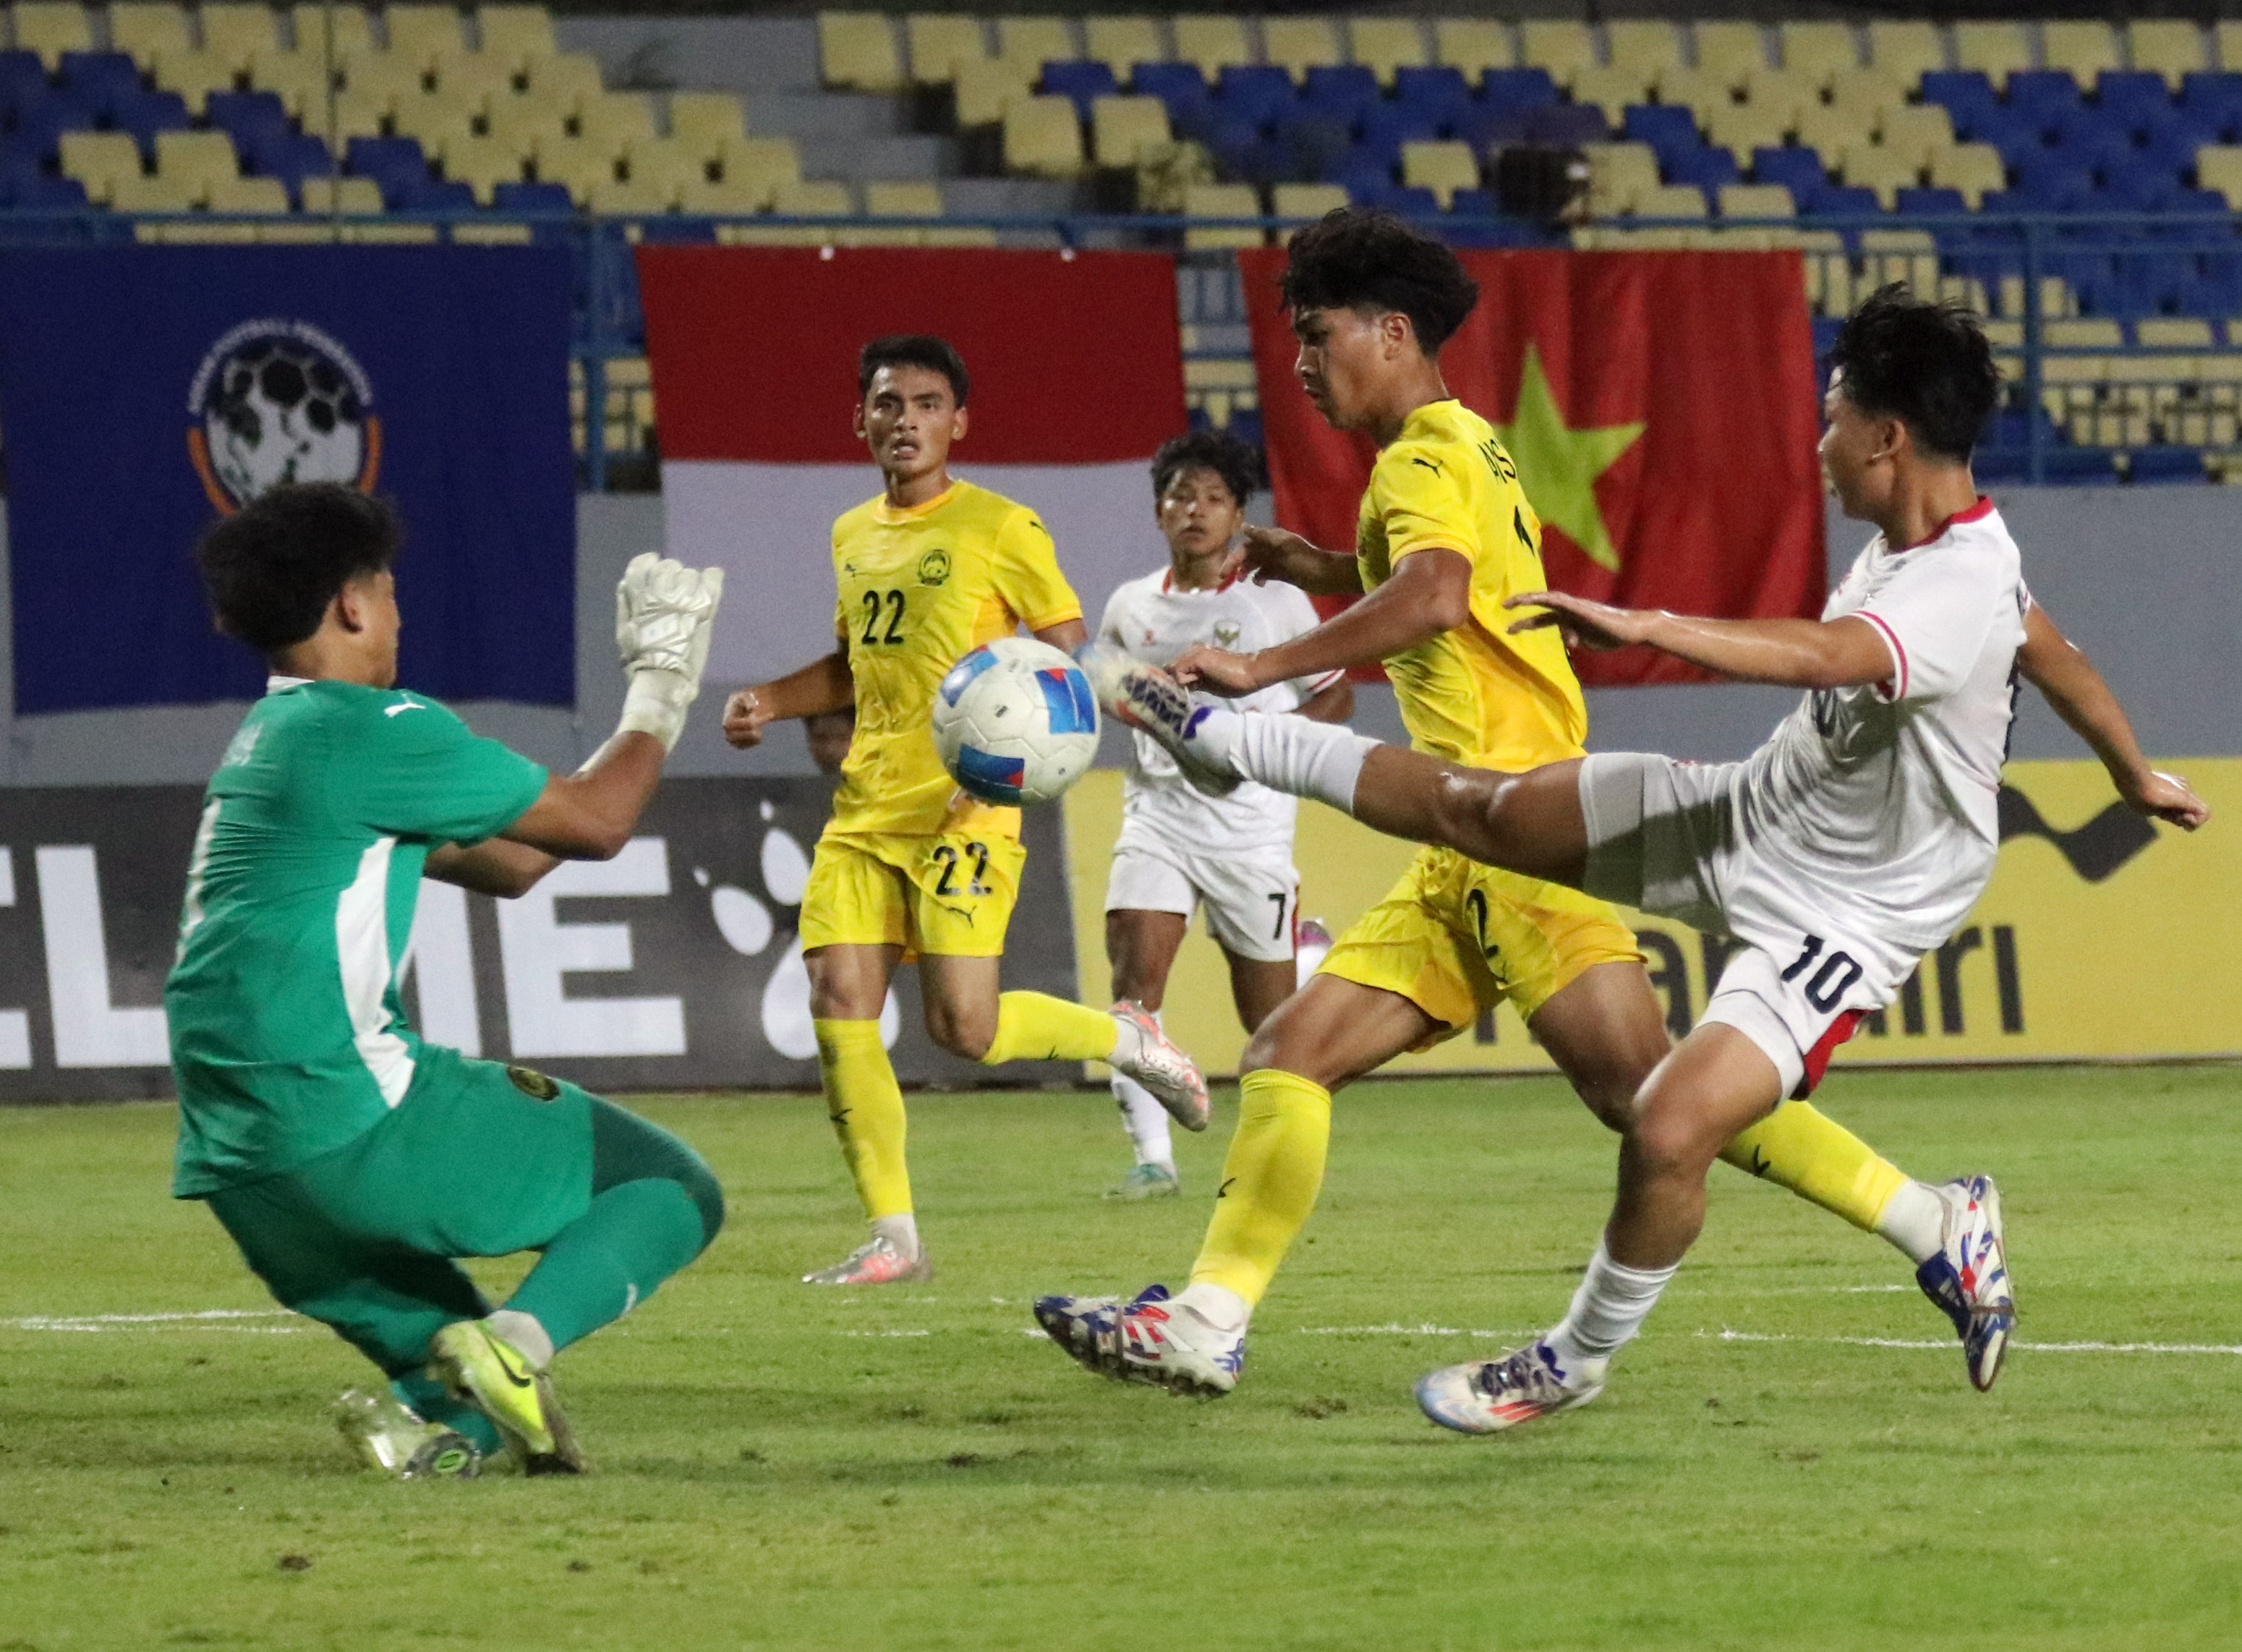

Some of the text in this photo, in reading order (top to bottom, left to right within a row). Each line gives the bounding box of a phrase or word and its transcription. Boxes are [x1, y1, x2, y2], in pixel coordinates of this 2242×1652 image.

[862, 589, 905, 645] 22
[933, 841, 993, 896] 22
[1267, 893, 1286, 940] 7
[1781, 934, 1864, 1015] 10
